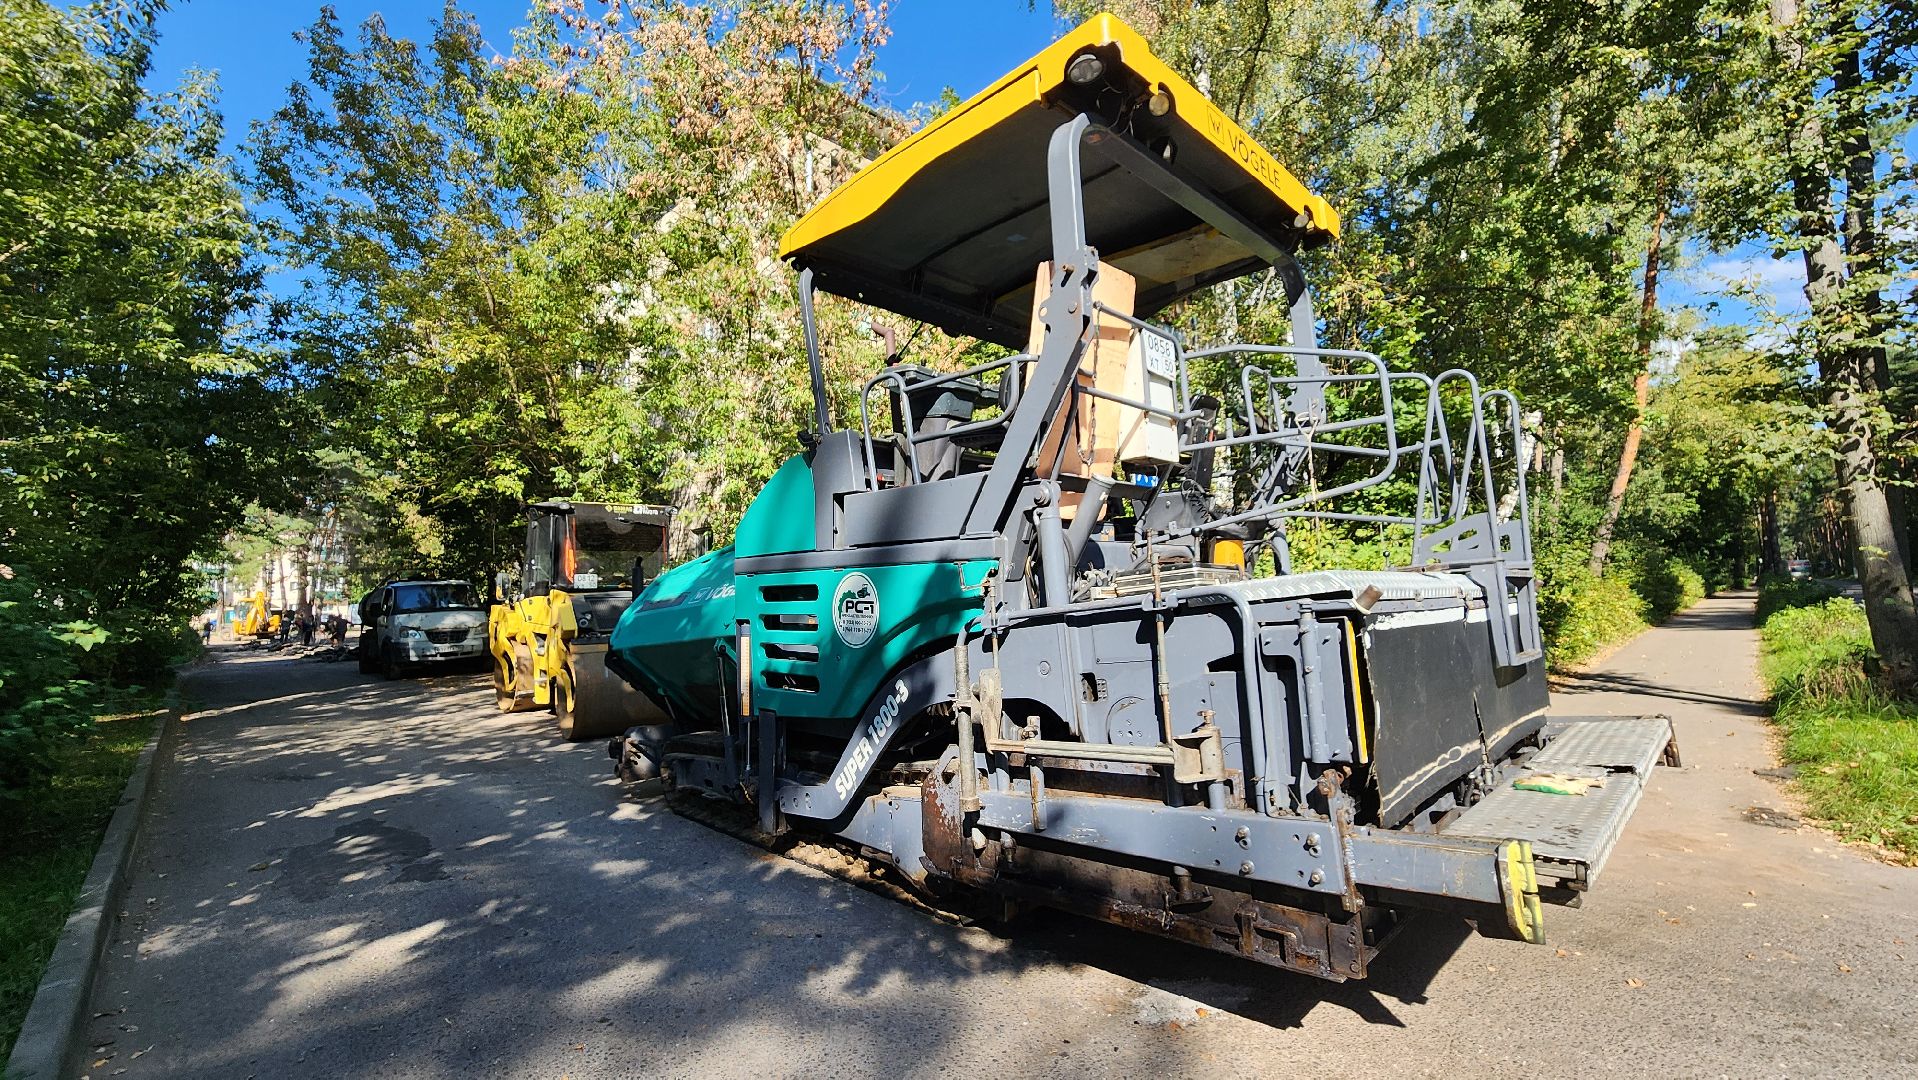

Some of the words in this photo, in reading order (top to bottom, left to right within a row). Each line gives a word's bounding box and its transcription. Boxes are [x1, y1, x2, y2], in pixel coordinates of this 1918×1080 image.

[1228, 129, 1281, 190] VÖGELE
[1148, 334, 1170, 357] 0858
[1164, 359, 1174, 373] 50
[835, 736, 873, 801] SUPER
[867, 679, 909, 745] 1800-3
